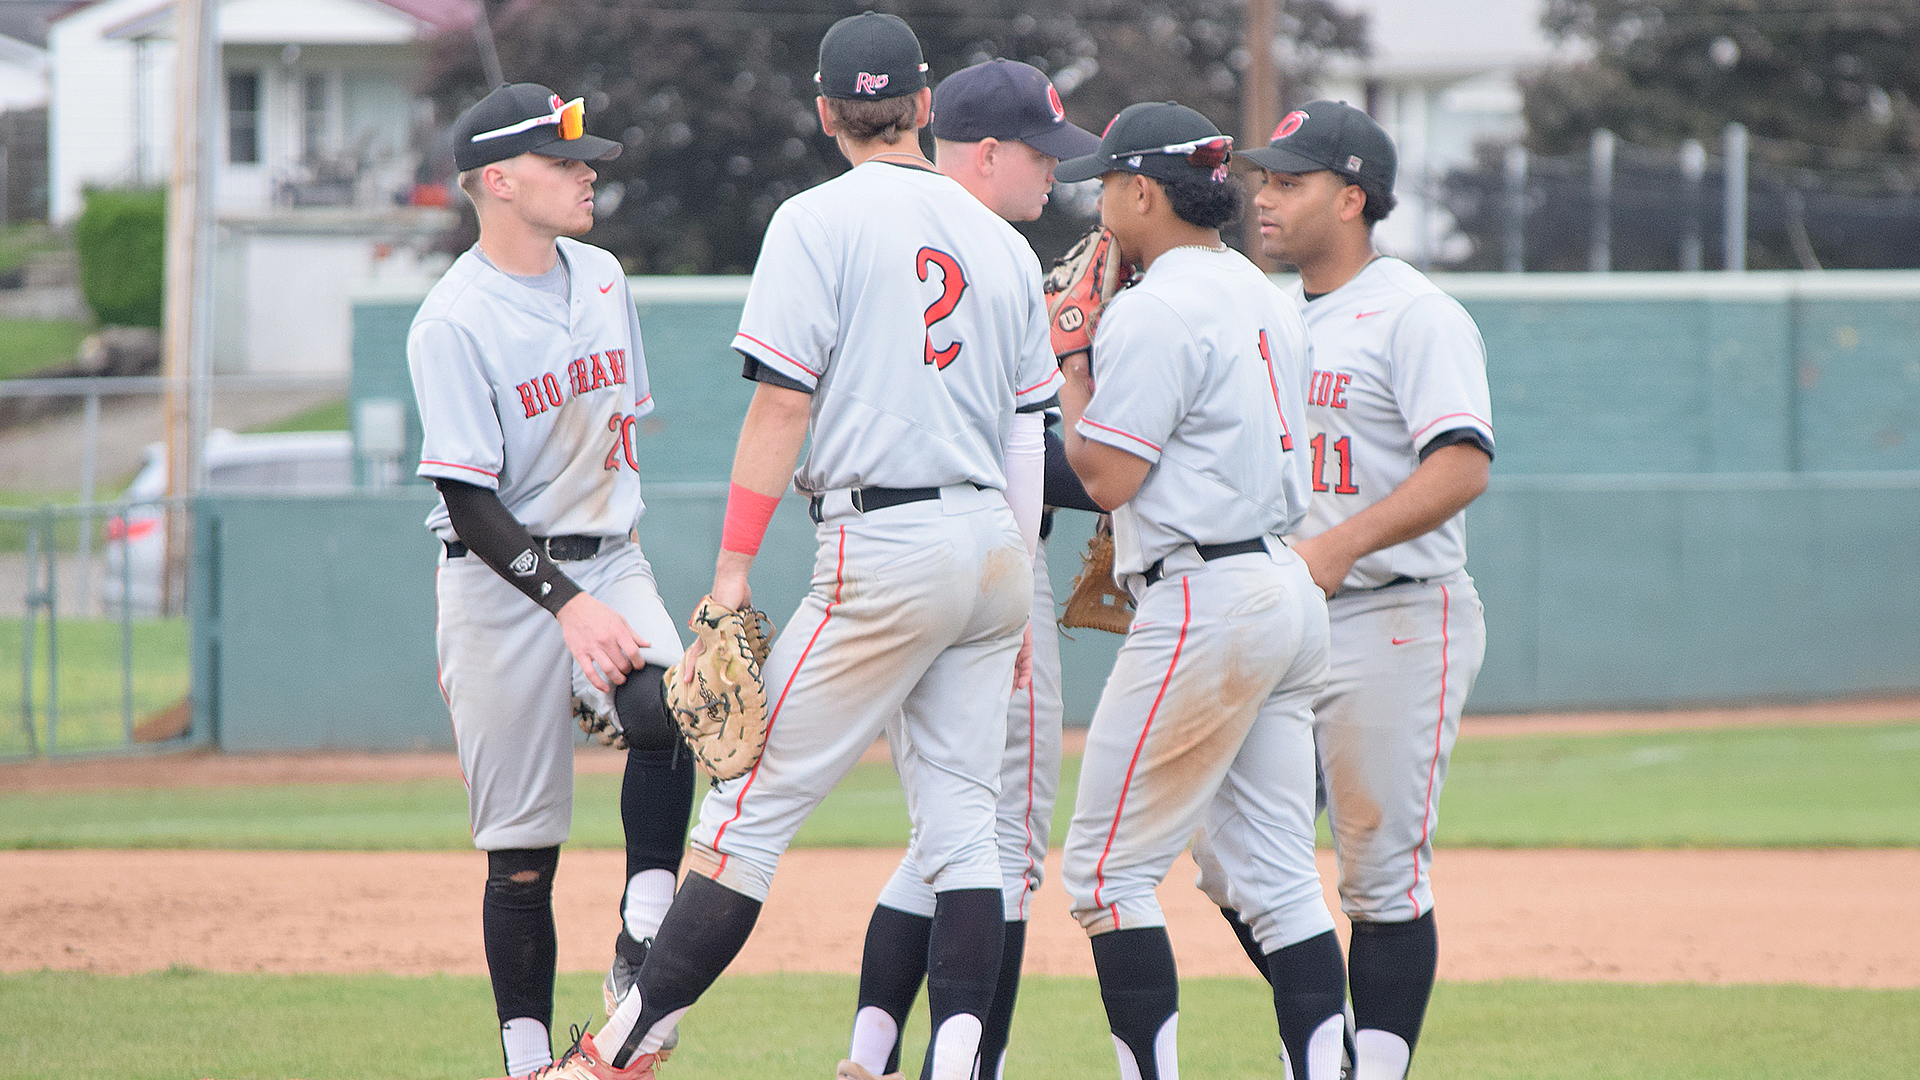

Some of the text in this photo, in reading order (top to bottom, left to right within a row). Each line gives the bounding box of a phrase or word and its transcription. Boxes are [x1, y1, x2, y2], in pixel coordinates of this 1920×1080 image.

[915, 245, 969, 371] 2
[516, 371, 564, 419] RIO
[1257, 328, 1295, 452] 1
[604, 411, 639, 474] 20
[1310, 431, 1359, 494] 11
